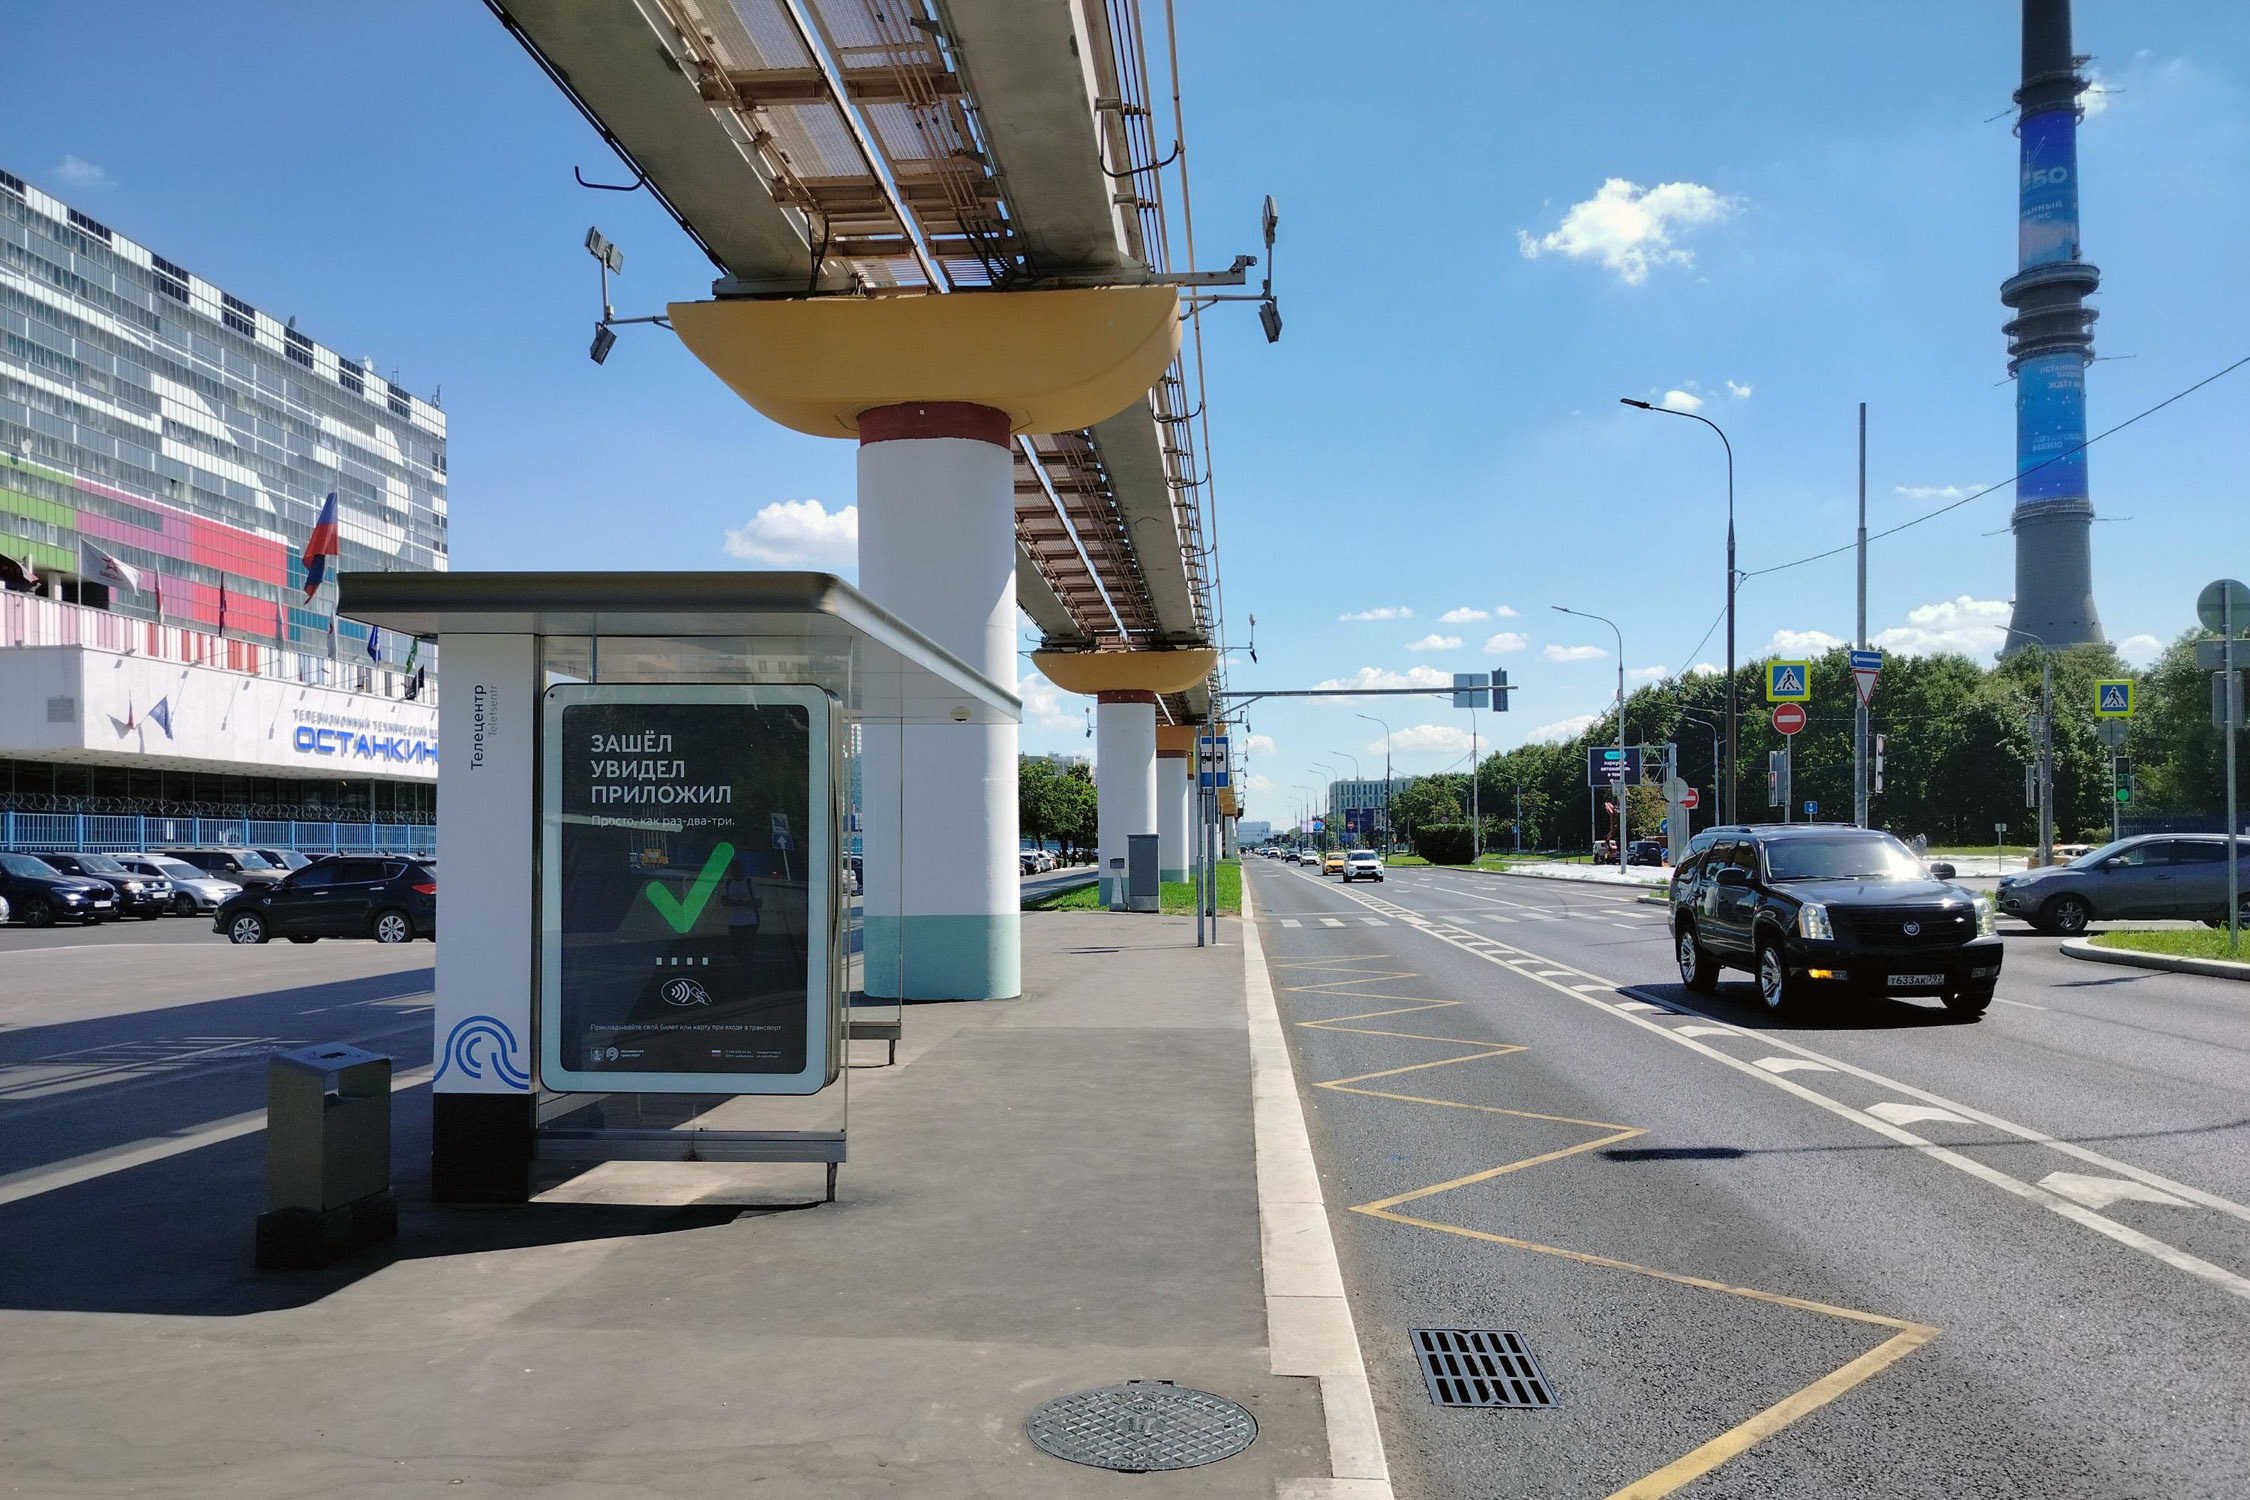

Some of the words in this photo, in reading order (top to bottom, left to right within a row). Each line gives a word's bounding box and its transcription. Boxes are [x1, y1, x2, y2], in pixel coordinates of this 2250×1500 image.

[488, 684, 498, 737] Teletsentr
[293, 708, 371, 731] ТЕЛЕВИЗИОННЫЙ
[372, 720, 428, 737] ТЕХНИЧЕСКИЙ
[471, 684, 487, 771] Телецентр
[590, 730, 672, 753] ЗАШЁЛ
[590, 760, 685, 782] УВИДЕЛ
[591, 785, 731, 804] ПРИЛОЖИЛ
[591, 815, 638, 827] Просто,
[640, 818, 660, 826] как
[662, 818, 735, 827] раз-два-три.
